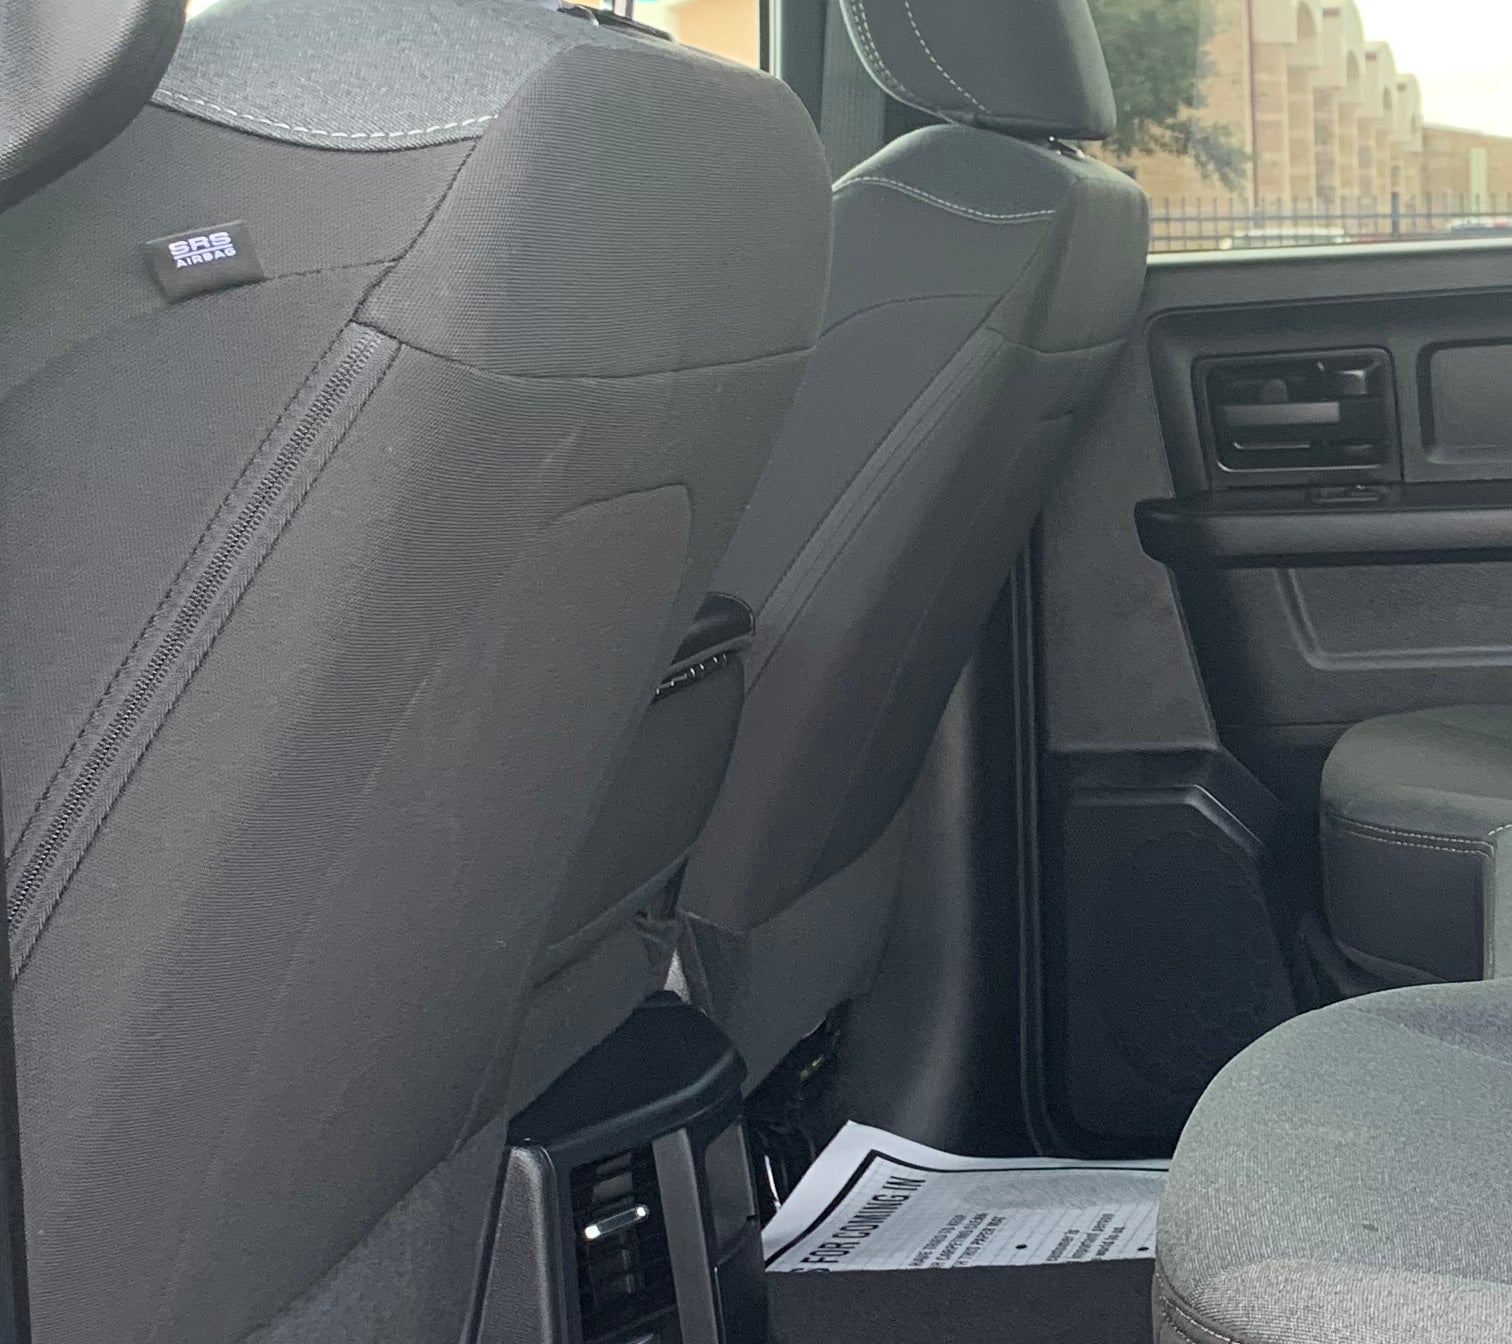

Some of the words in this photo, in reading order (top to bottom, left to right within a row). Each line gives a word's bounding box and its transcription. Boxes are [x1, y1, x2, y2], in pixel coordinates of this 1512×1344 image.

[168, 232, 232, 256] SRS
[176, 248, 236, 268] AIRBAG
[800, 1242, 861, 1263] FOR
[832, 1194, 910, 1238] COMING
[882, 1176, 926, 1190] IN
